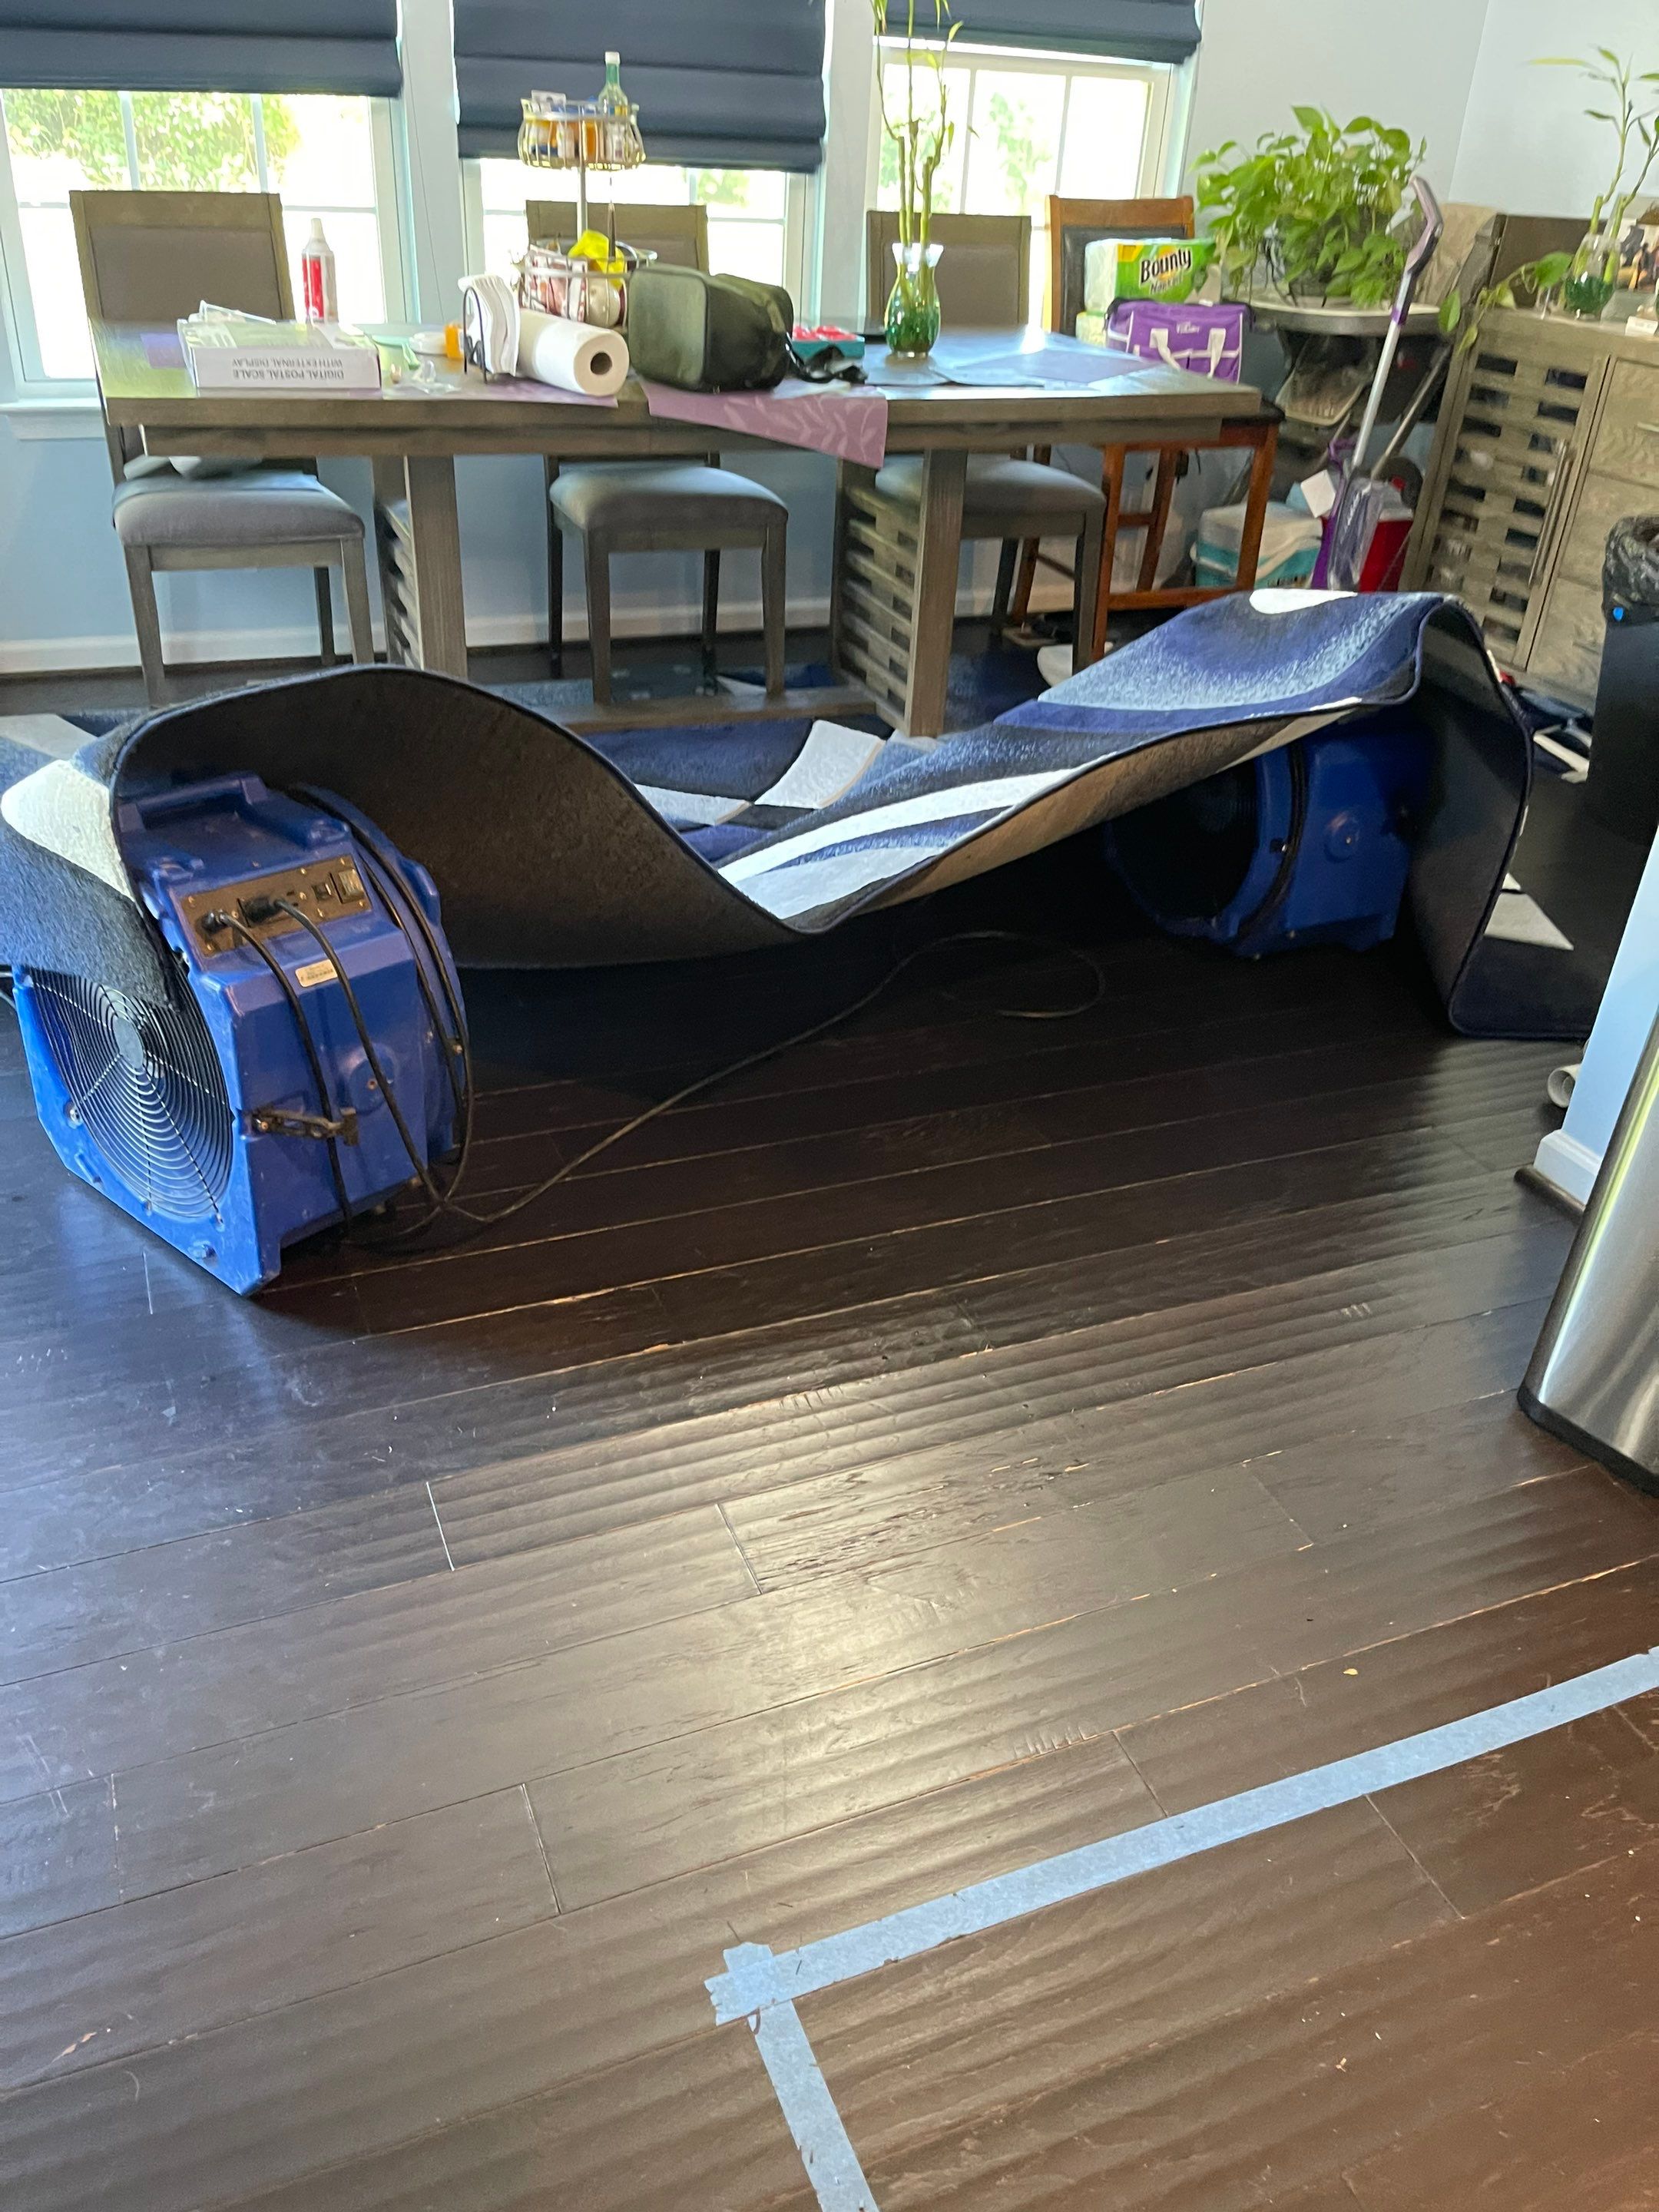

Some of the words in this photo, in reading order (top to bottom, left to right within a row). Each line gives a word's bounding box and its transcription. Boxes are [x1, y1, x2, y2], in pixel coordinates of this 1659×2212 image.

[1141, 249, 1192, 284] Bounty
[232, 358, 269, 368] DISPLAY
[272, 358, 317, 368] EXTERNAL
[319, 358, 343, 368] WITH
[233, 369, 265, 379] SCALE
[269, 369, 305, 379] POSTAL
[308, 369, 345, 379] DIGITAL
